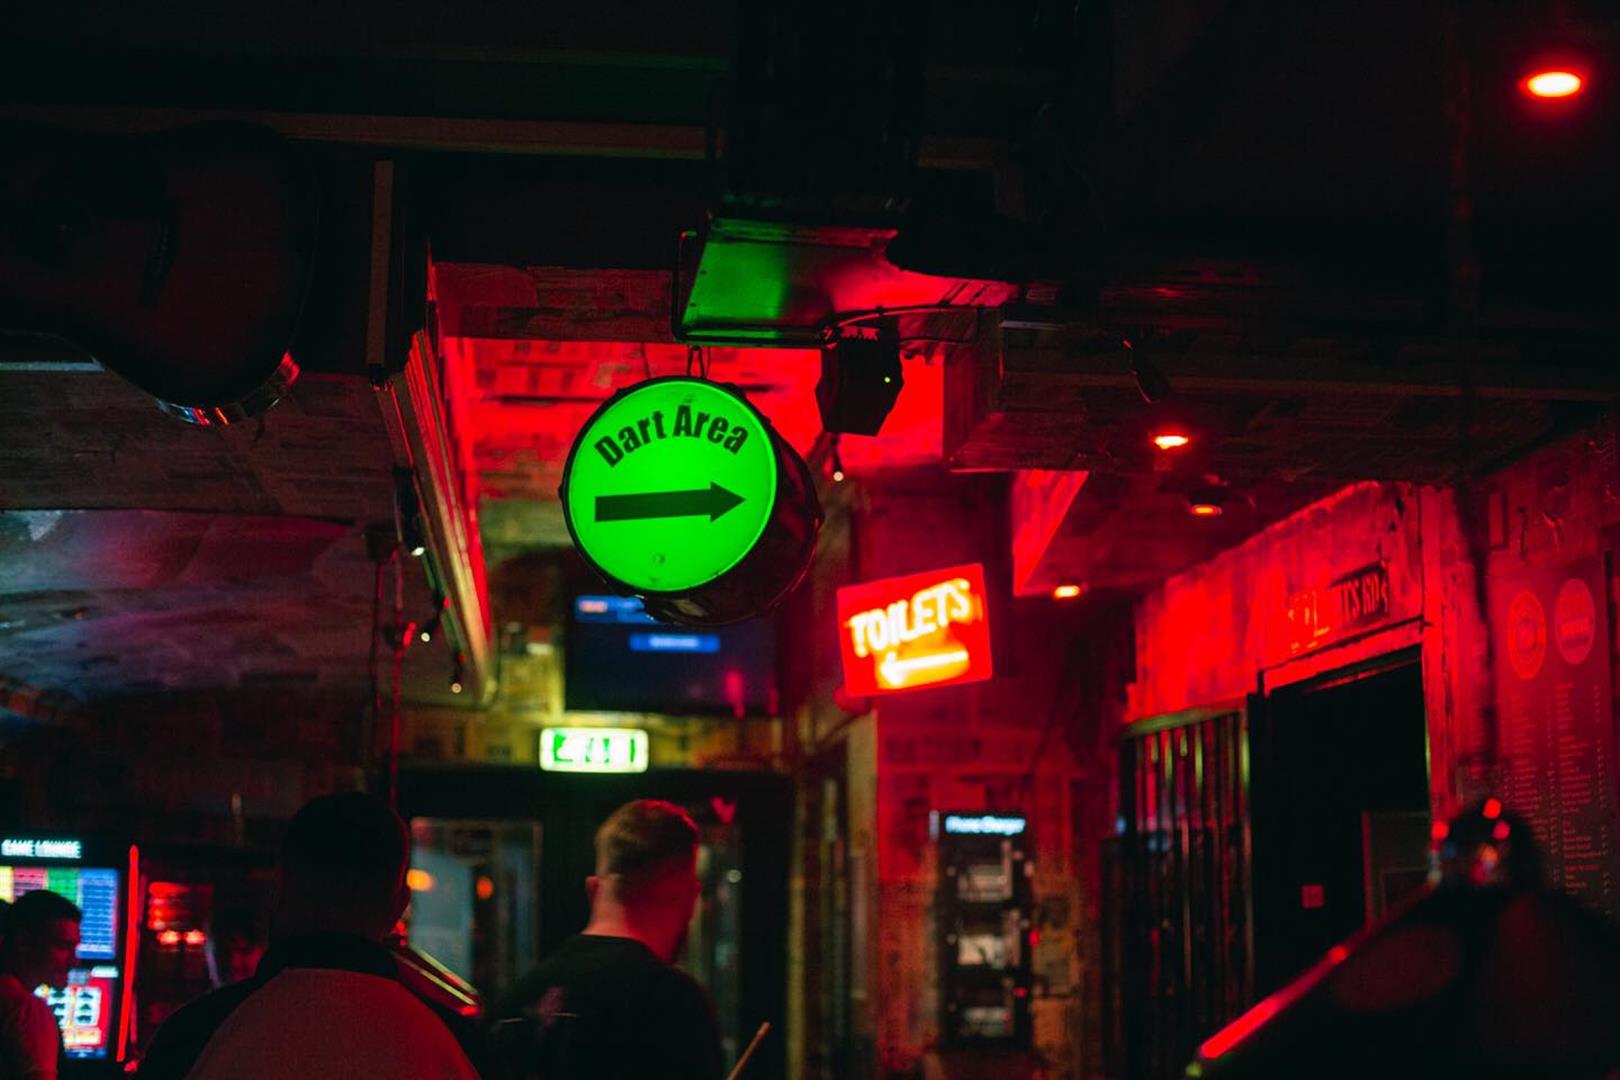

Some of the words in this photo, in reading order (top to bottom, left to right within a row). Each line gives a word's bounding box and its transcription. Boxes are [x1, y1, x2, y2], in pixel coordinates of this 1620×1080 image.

[594, 410, 667, 468] Dart
[673, 404, 749, 455] Area
[849, 577, 972, 658] TOILETS
